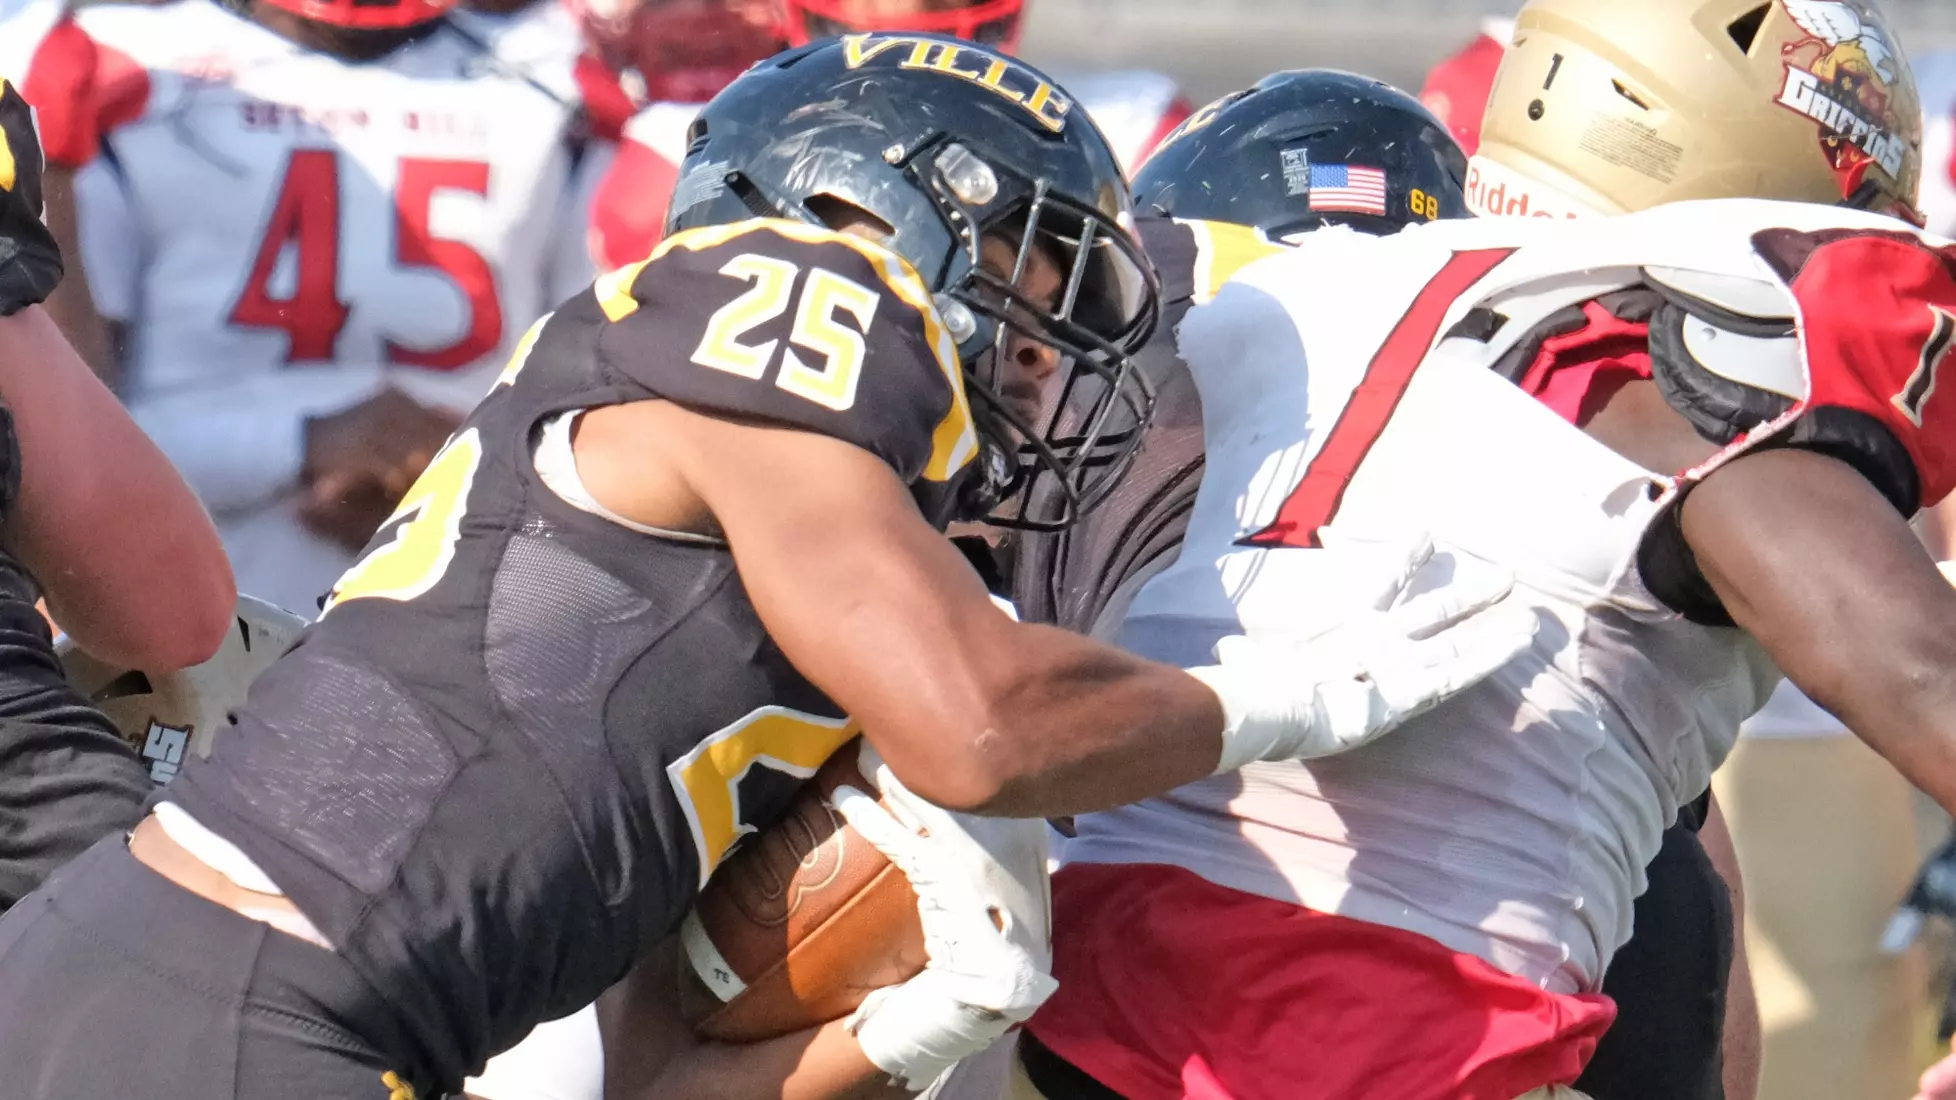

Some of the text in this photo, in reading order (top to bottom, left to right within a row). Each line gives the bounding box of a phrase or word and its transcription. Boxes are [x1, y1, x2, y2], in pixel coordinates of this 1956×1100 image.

[841, 31, 1073, 133] VILLE
[1542, 52, 1565, 91] 1
[1410, 188, 1439, 221] 68
[226, 148, 503, 372] 45
[689, 253, 881, 411] 25
